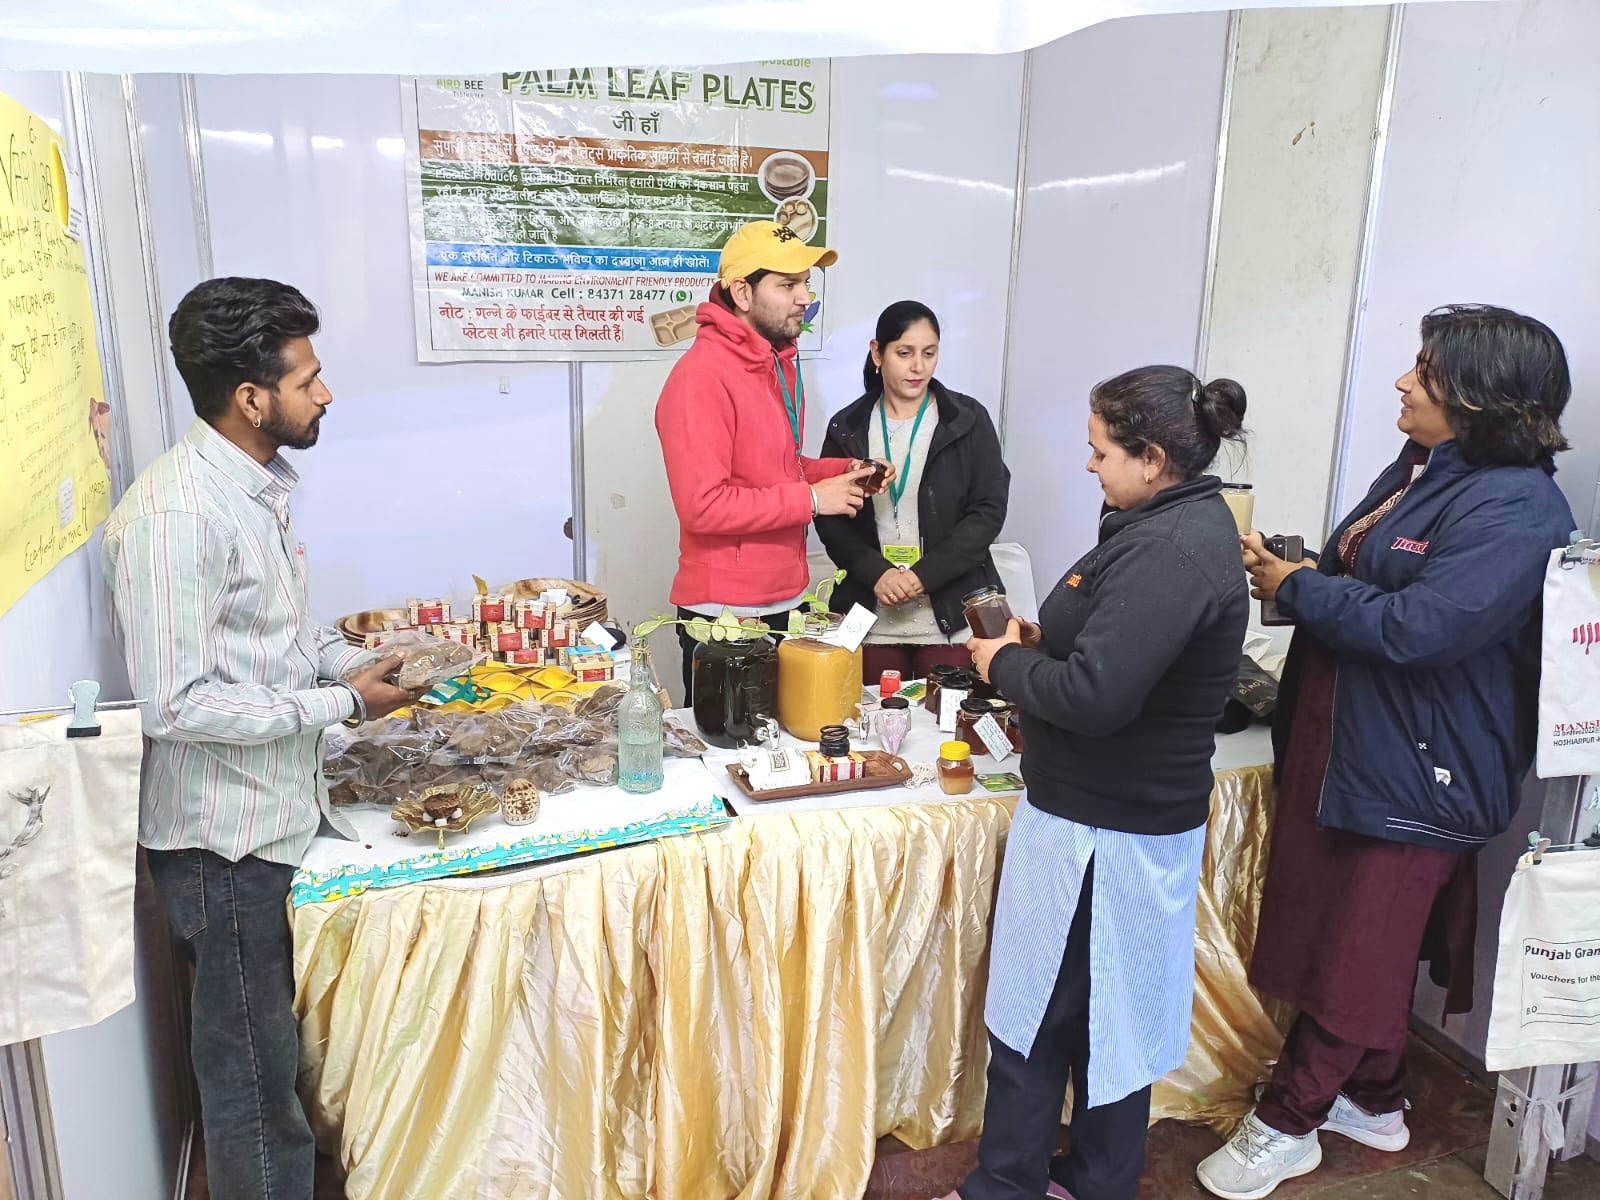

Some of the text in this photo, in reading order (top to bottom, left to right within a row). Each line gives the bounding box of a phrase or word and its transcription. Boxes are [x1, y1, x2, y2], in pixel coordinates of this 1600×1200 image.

[436, 79, 484, 90] BIRD BEE
[502, 66, 816, 114] PALM LEAF PLATES
[612, 110, 635, 132] जी
[607, 145, 647, 165] प्राकृतिक
[649, 147, 680, 165] सामग्री
[682, 147, 690, 165] से
[473, 169, 519, 183] Products
[439, 250, 458, 263] एक
[461, 249, 498, 264] सुरक्षित
[522, 250, 559, 264] टिकाऊ
[594, 254, 609, 265] का
[434, 271, 449, 282] WE
[450, 272, 469, 283] ARE
[470, 272, 522, 283] COMMITTED
[525, 274, 537, 284] TO
[574, 275, 634, 286] ENVIRONMENT
[635, 276, 673, 287] FRIENDLY
[462, 287, 504, 298] MANISH
[506, 287, 545, 299] KUMAR
[551, 287, 575, 299] Cell
[587, 288, 624, 300] 84371
[629, 289, 666, 301] 28477
[438, 302, 465, 320] नोट
[475, 303, 502, 320] गन्ने
[505, 304, 518, 321] के
[563, 304, 575, 321] से
[577, 304, 607, 322] तैयार
[608, 304, 625, 322] की
[627, 305, 645, 324] गई
[500, 322, 516, 340] भी
[518, 323, 546, 342] हमारे
[549, 327, 573, 341] पास
[574, 323, 611, 341] मिलती
[1524, 945, 1572, 961] Punjab
[1530, 971, 1576, 985] Vouchers
[1577, 976, 1588, 985] for
